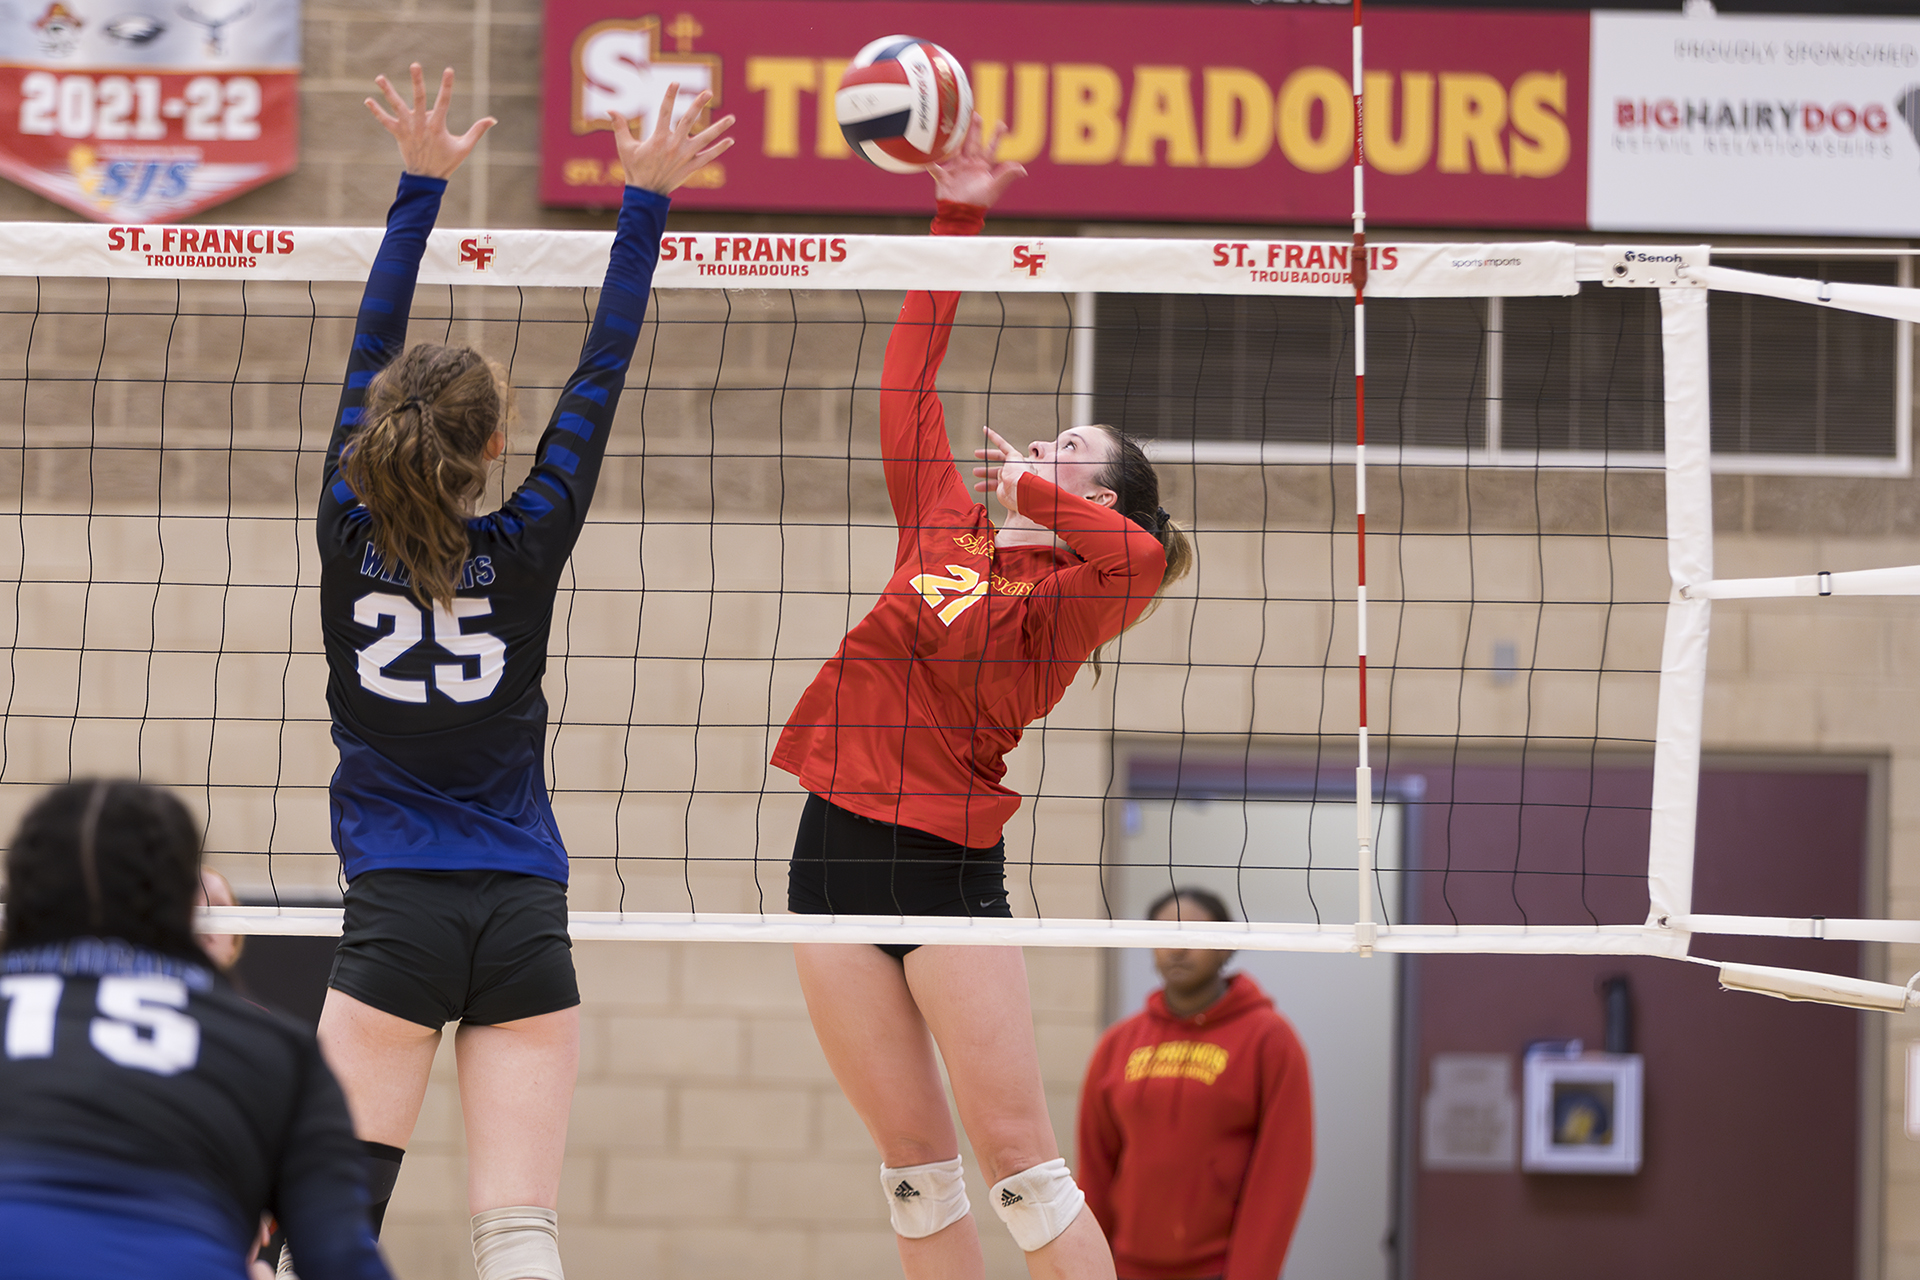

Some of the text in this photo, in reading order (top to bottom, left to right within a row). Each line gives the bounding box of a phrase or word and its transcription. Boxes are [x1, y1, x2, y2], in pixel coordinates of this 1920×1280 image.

[20, 71, 262, 140] 2021-22
[746, 56, 1571, 178] TUBADOURS
[107, 227, 295, 255] ST. FRANCIS
[660, 236, 847, 263] ST. FRANCIS
[145, 254, 258, 268] TROUBADOURS
[697, 263, 810, 277] TROUBADOURS
[1213, 243, 1399, 271] ST. FRANIS
[1637, 252, 1683, 263] Senoh
[1250, 270, 1357, 285] TROUBADOUR
[352, 591, 508, 705] 25
[0, 973, 201, 1076] 15
